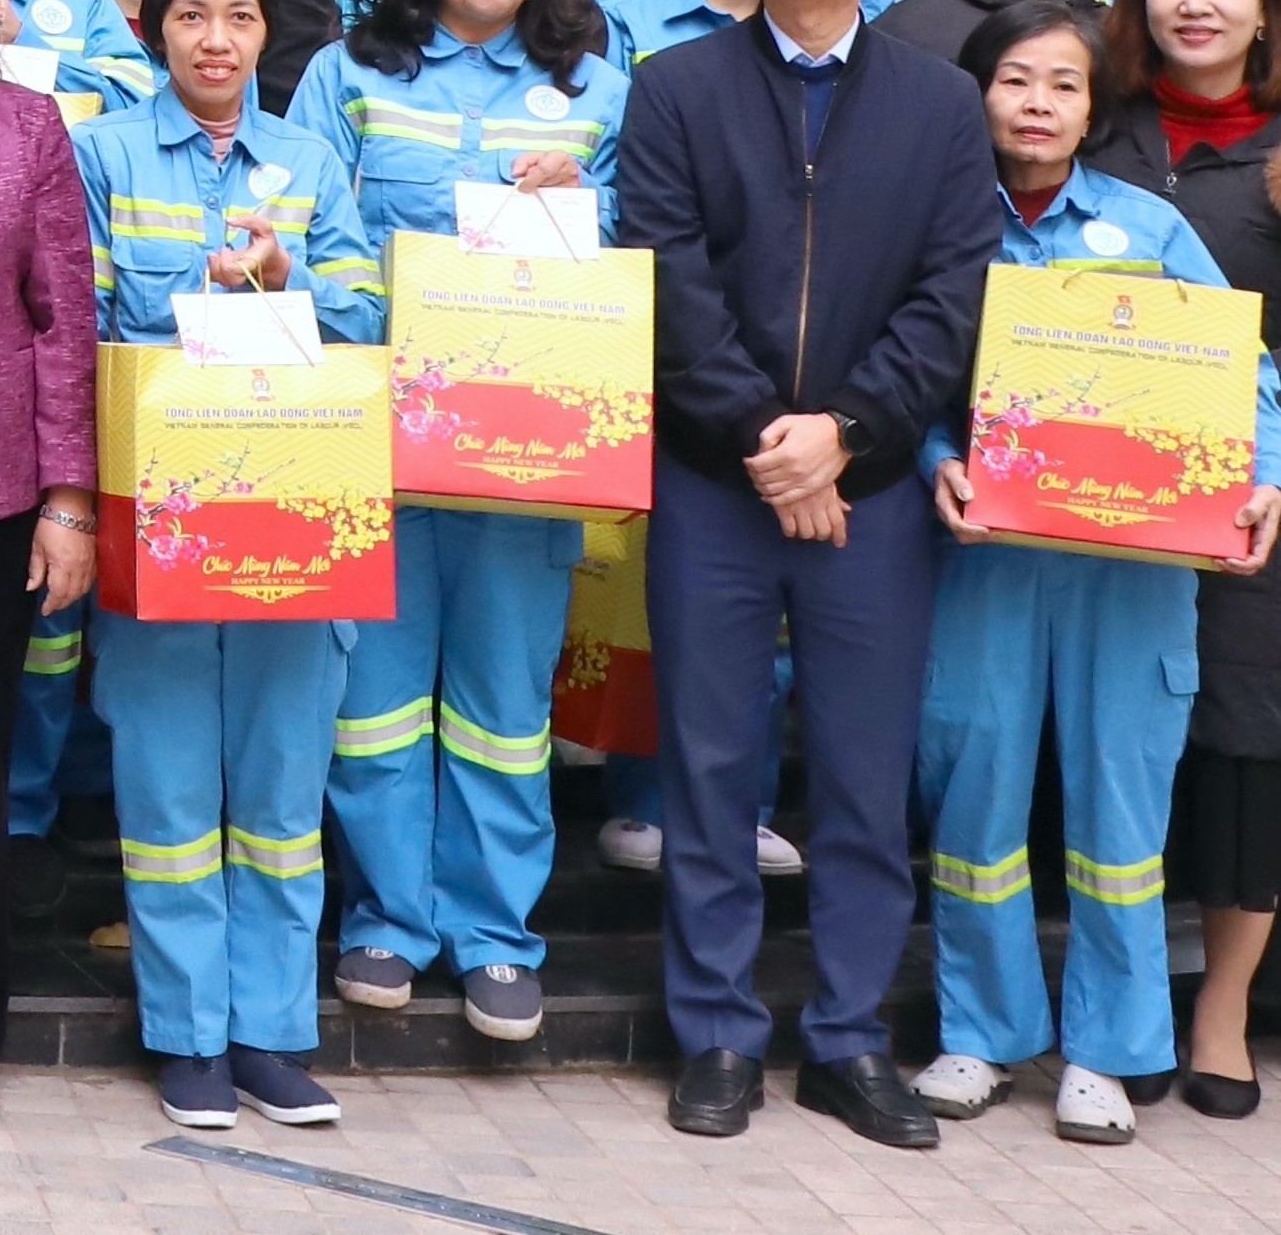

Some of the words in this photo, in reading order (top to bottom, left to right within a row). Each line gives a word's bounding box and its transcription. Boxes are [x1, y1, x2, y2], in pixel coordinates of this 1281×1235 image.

[482, 456, 511, 465] HAPPY
[535, 460, 559, 468] YEAR
[1066, 497, 1097, 507] HAPPY
[1122, 503, 1148, 513] YEAR
[231, 577, 259, 585] HAPPY
[282, 577, 305, 585] YEAR
